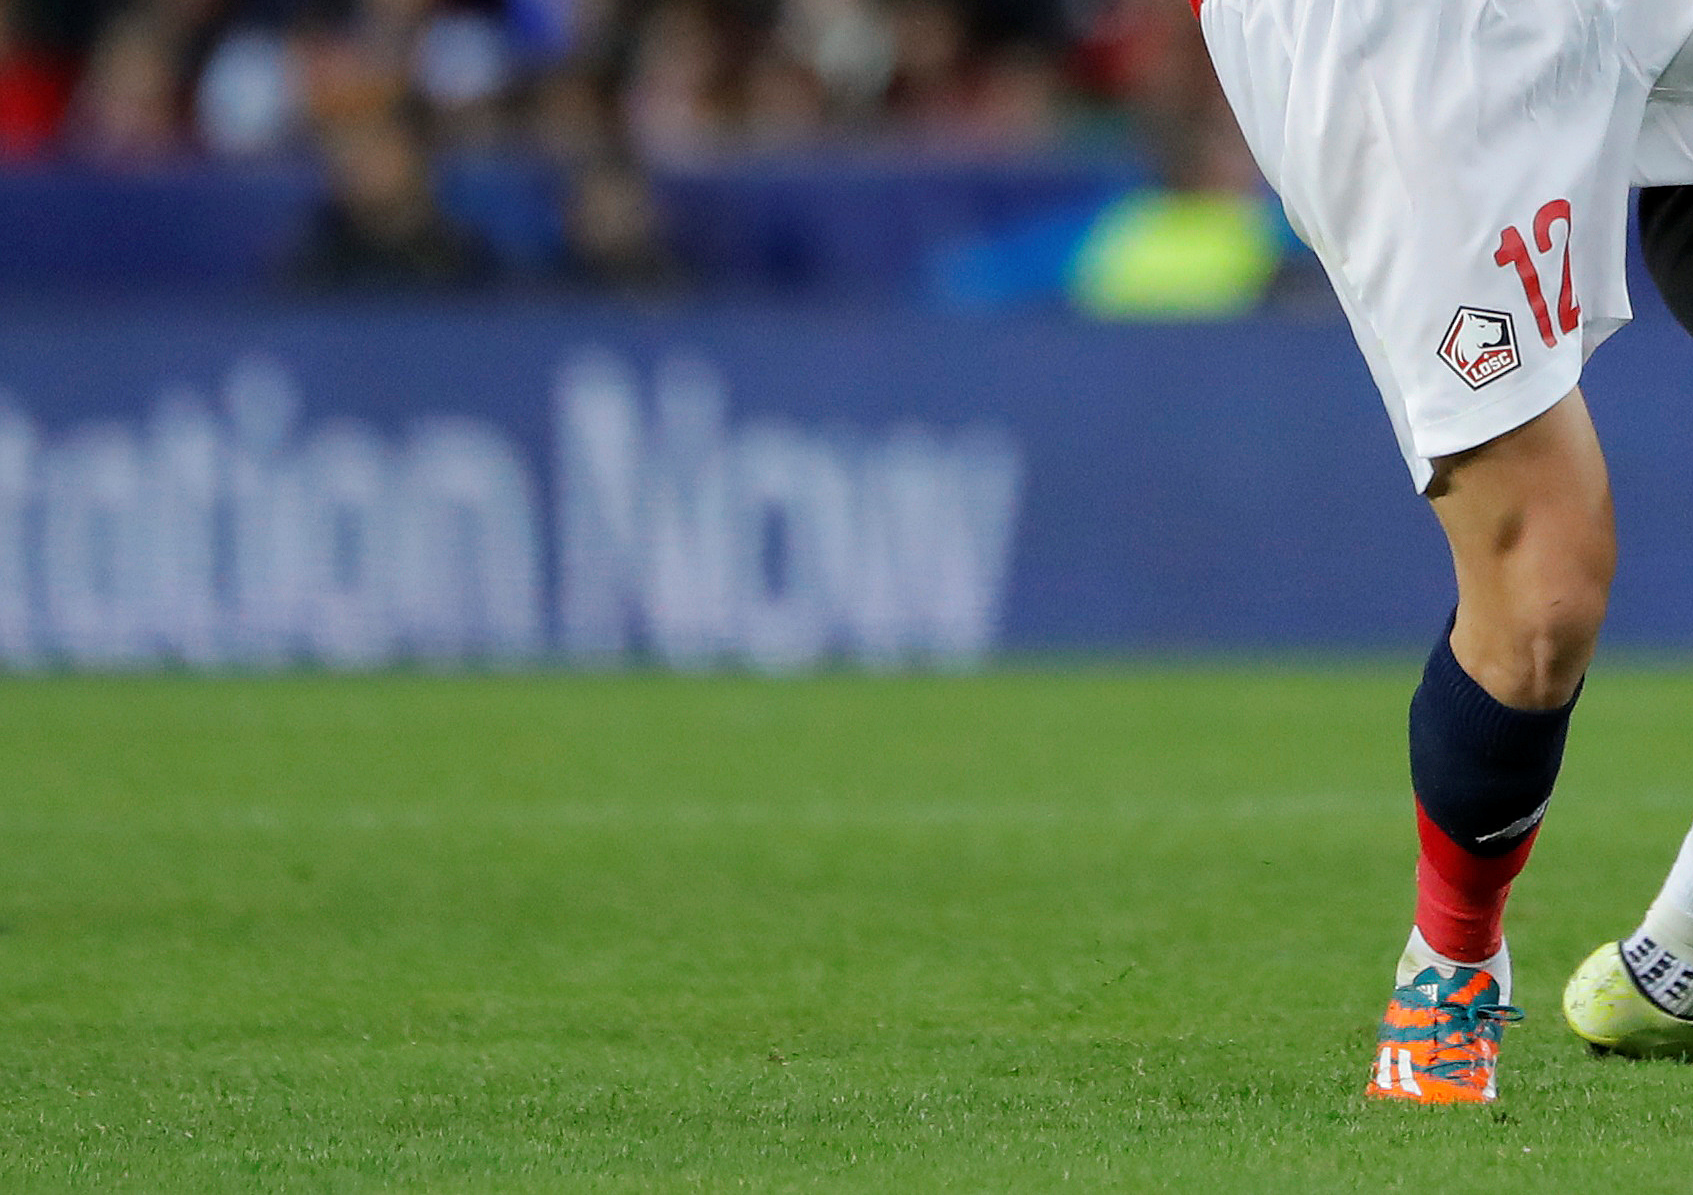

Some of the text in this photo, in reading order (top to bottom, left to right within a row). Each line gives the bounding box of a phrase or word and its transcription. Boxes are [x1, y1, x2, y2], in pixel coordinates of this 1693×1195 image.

[1494, 198, 1582, 349] 12
[1470, 351, 1512, 380] LOSC
[553, 346, 1023, 672] Now
